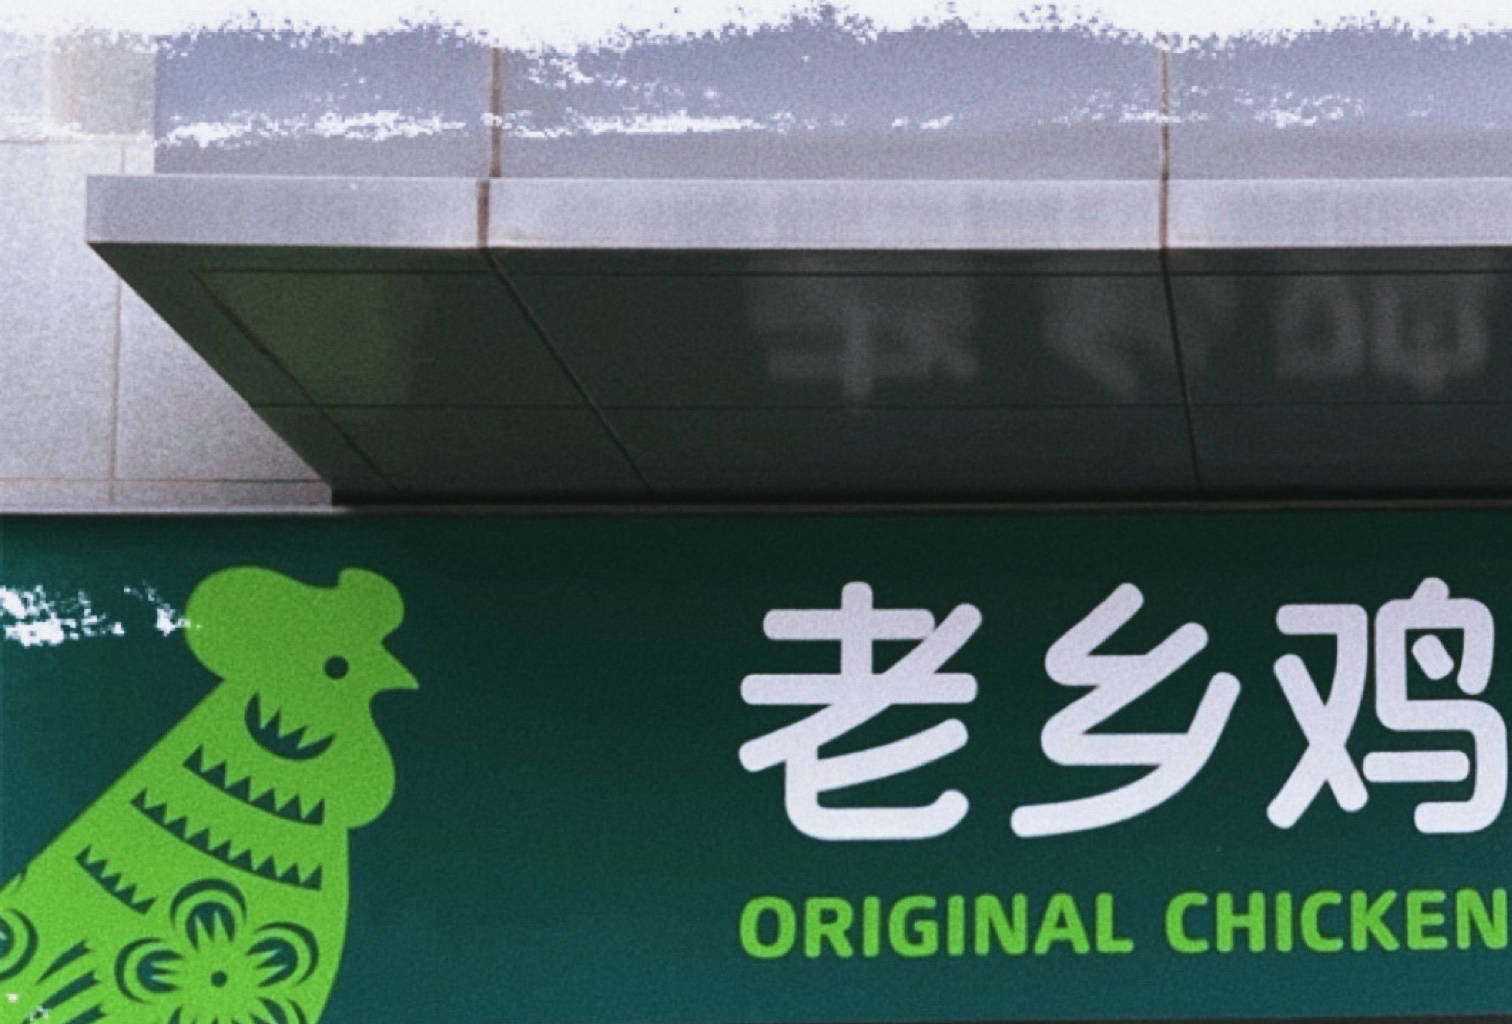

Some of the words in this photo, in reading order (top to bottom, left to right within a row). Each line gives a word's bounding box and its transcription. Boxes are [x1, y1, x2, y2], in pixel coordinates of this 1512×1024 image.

[739, 577, 1508, 841] 老乡鸡
[739, 892, 1134, 959] ORIGINAL
[1165, 887, 1508, 953] CHICKEN
